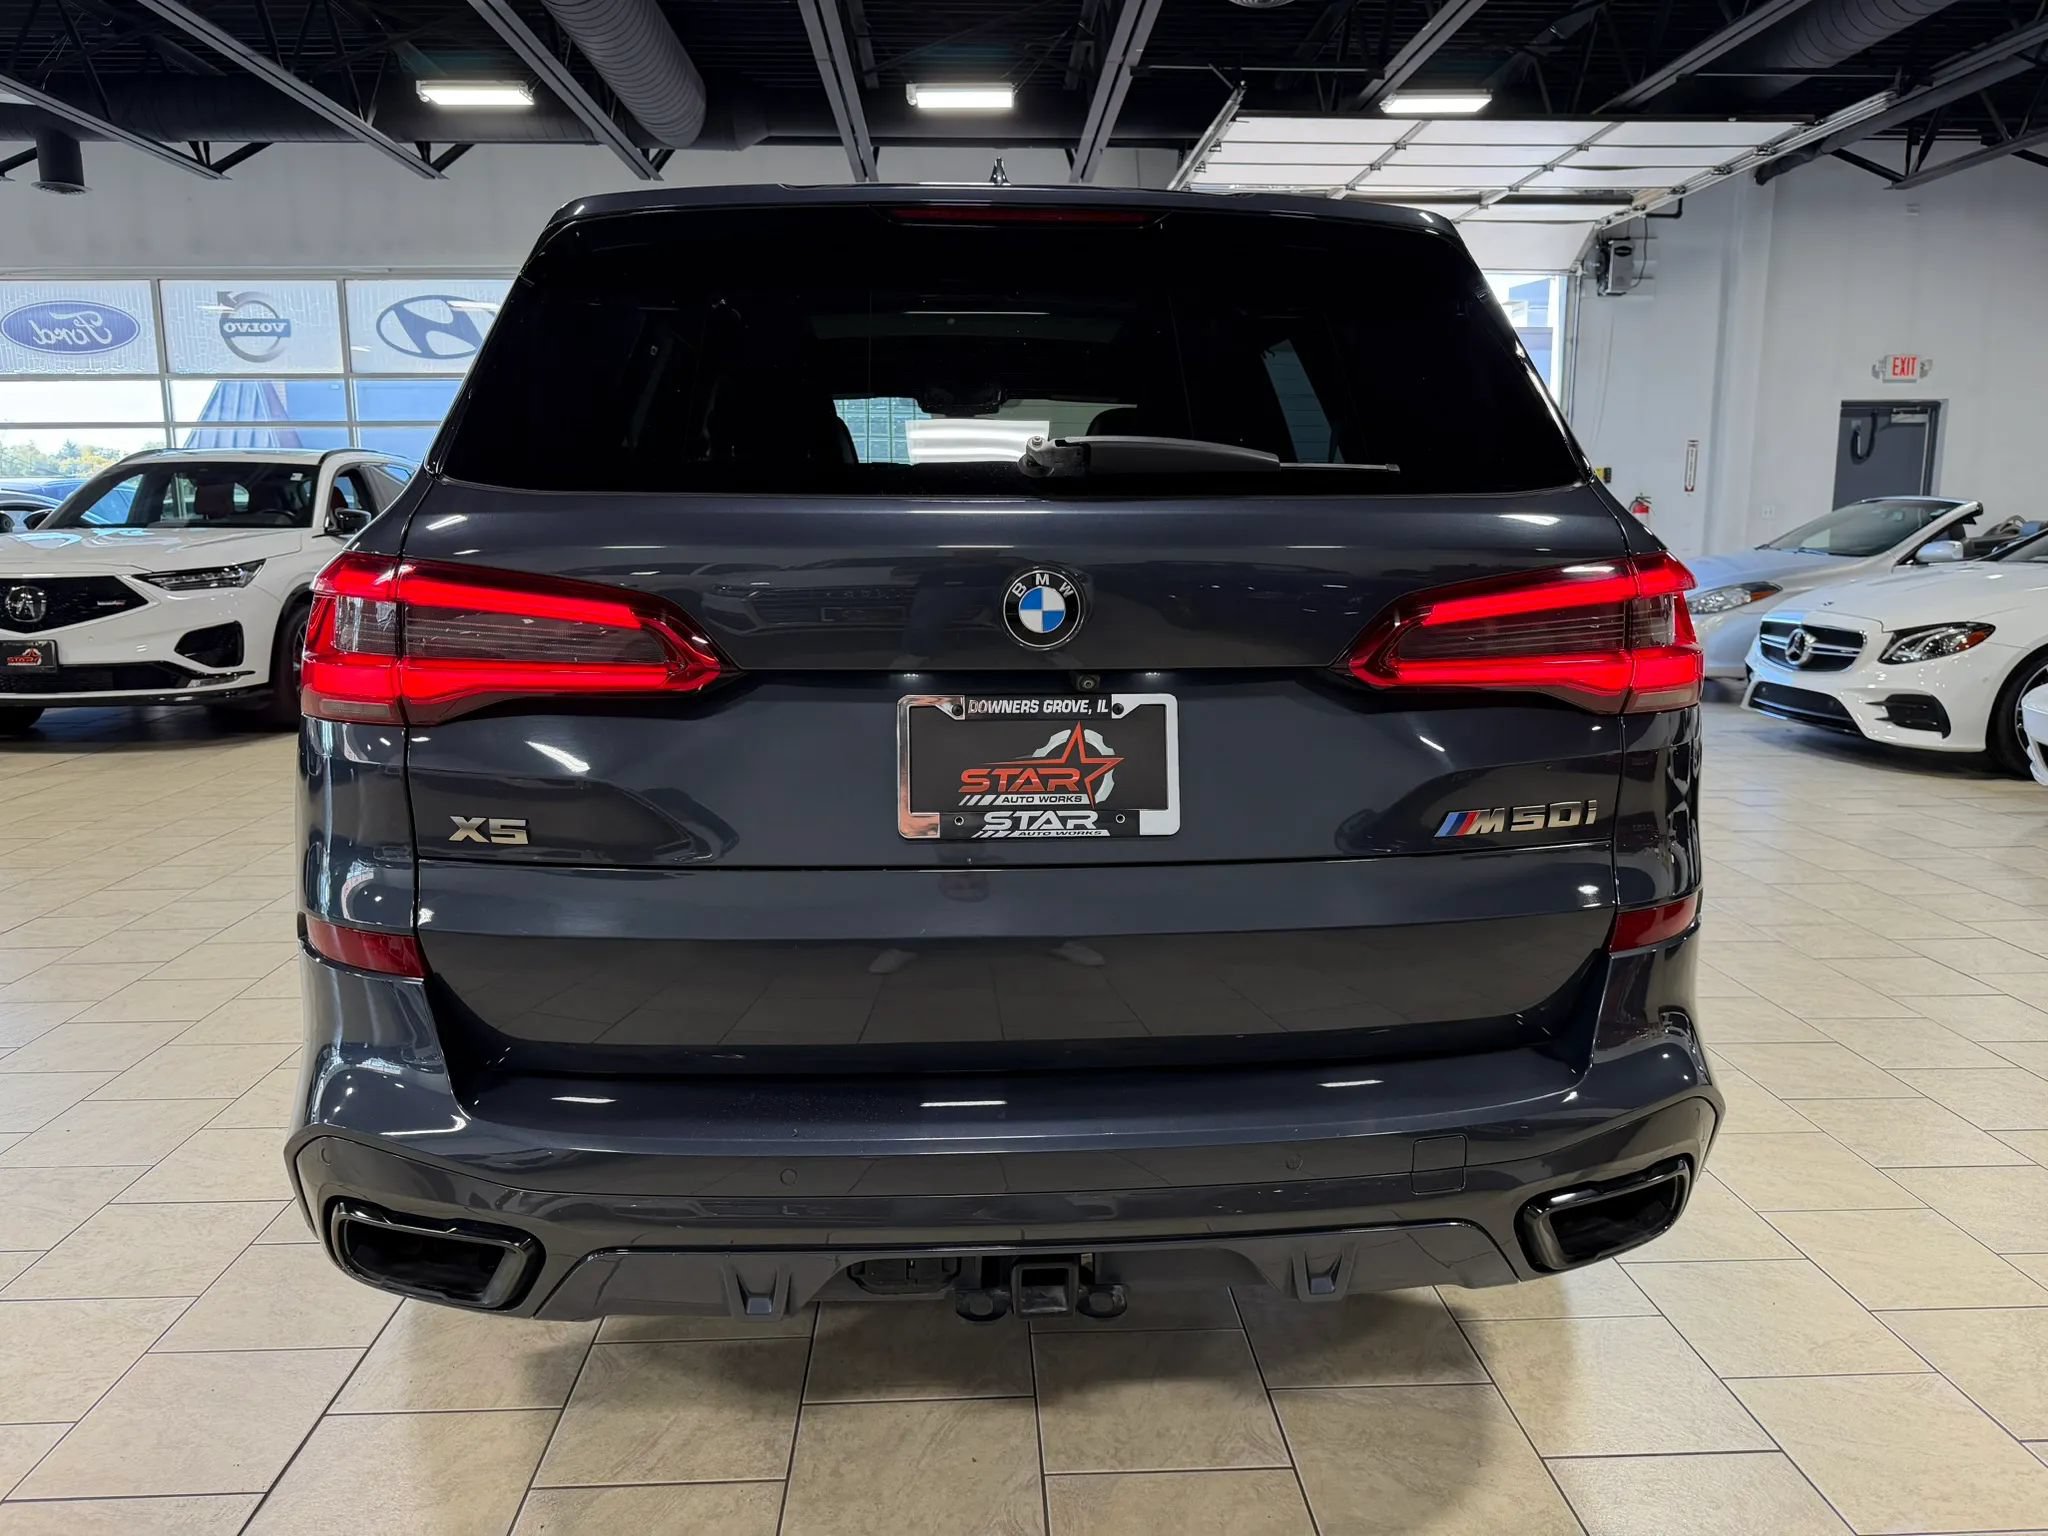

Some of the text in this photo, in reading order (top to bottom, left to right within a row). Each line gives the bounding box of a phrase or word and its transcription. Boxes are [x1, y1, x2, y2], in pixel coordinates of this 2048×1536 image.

[1892, 356, 1917, 377] EXIT
[1011, 573, 1075, 598] BMW
[968, 699, 1109, 715] DOWNERS GROVE, IL
[958, 767, 1081, 793] STAR
[1001, 795, 1083, 804] AUTO WORKS
[448, 816, 529, 845] X5
[982, 810, 1099, 831] STAR
